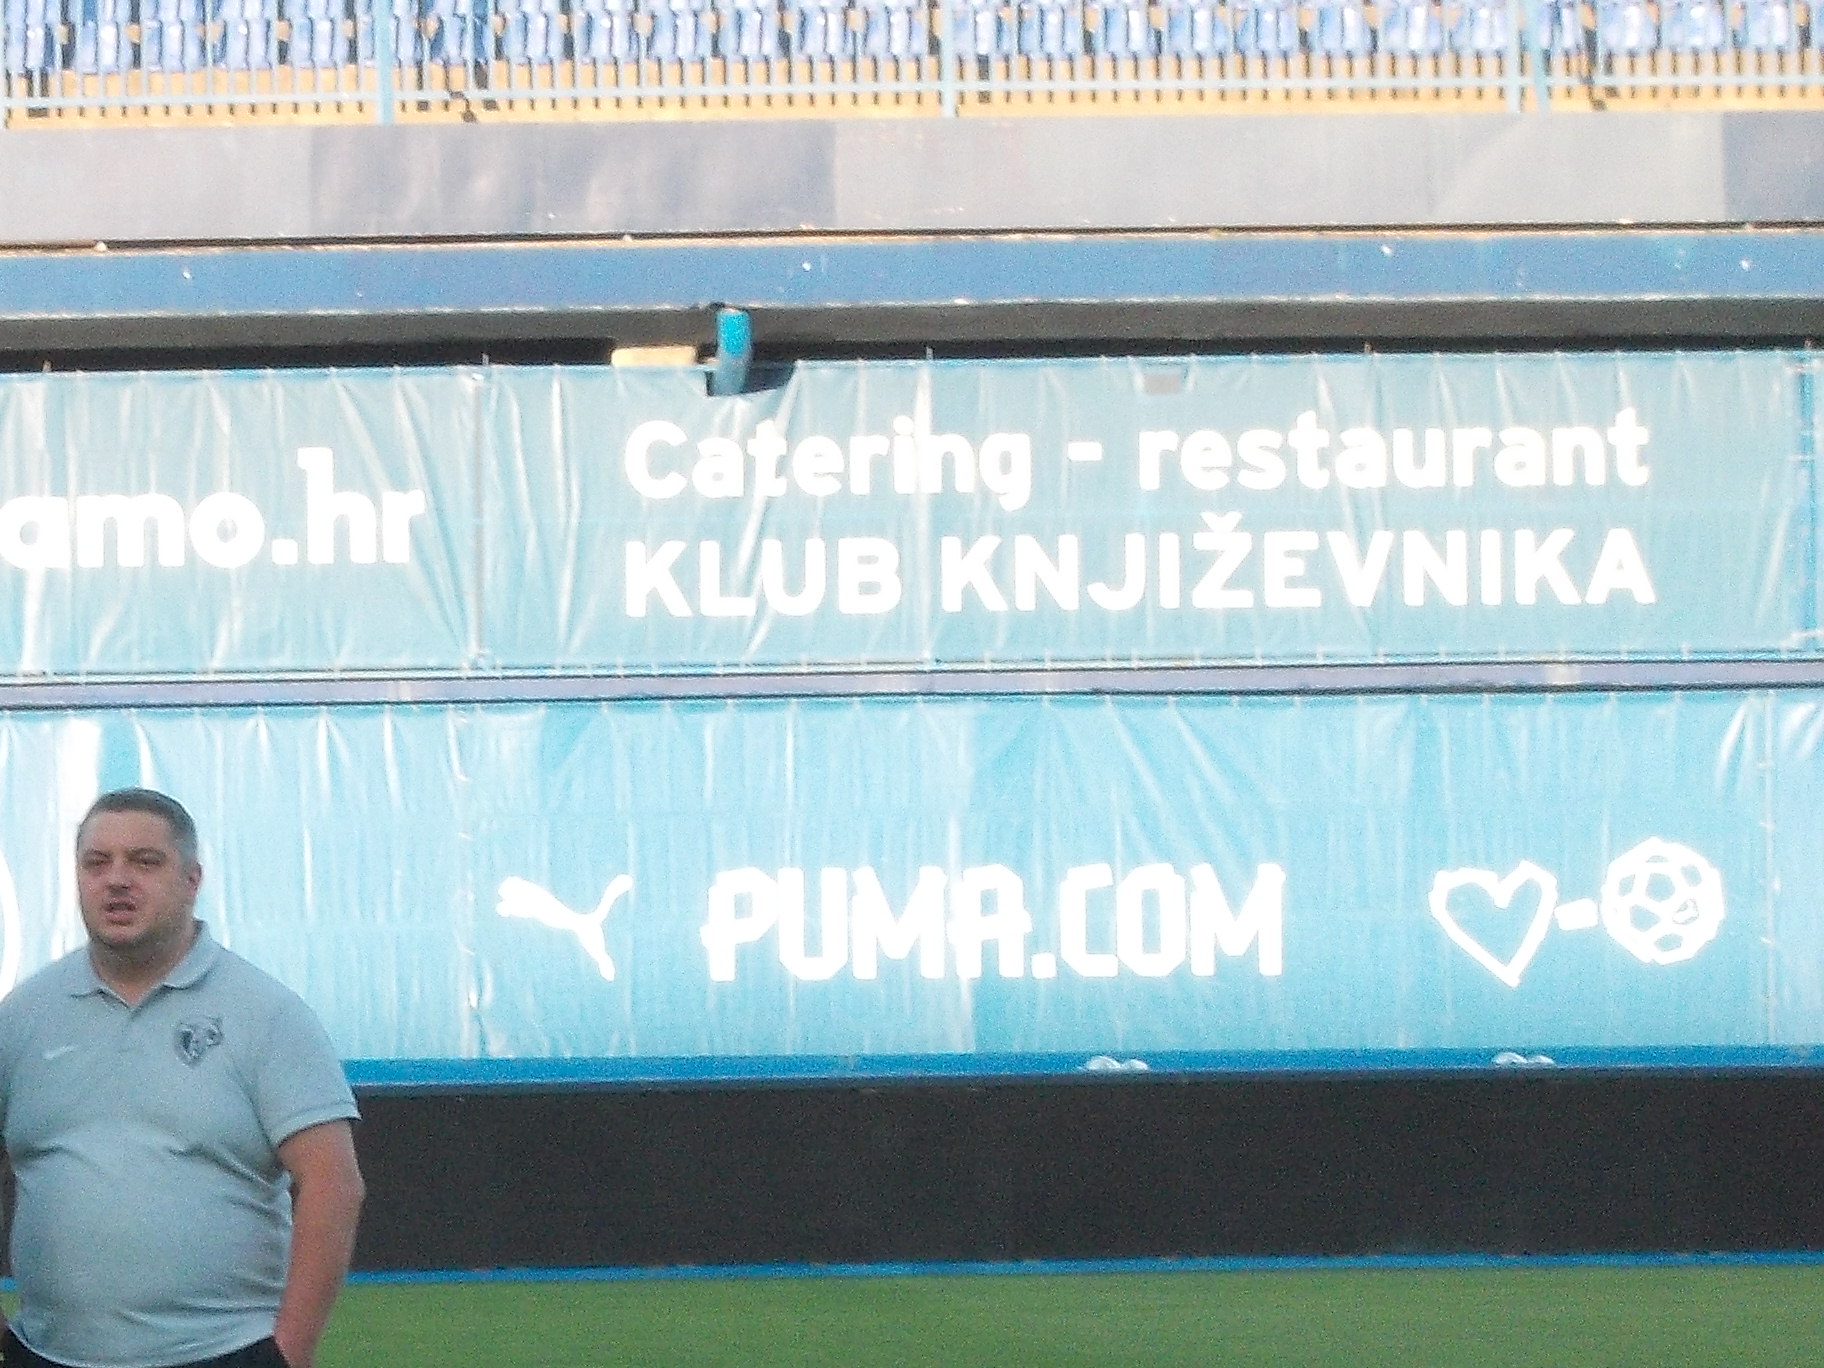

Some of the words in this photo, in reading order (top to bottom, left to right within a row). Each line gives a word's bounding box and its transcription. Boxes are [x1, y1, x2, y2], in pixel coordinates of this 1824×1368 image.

[624, 415, 1032, 511] Catering
[1138, 407, 1650, 490] restaurant
[624, 537, 902, 618] KLUB
[940, 511, 1656, 612] KNJIŽEVNIKA
[701, 863, 1286, 982] PUMA.COM
